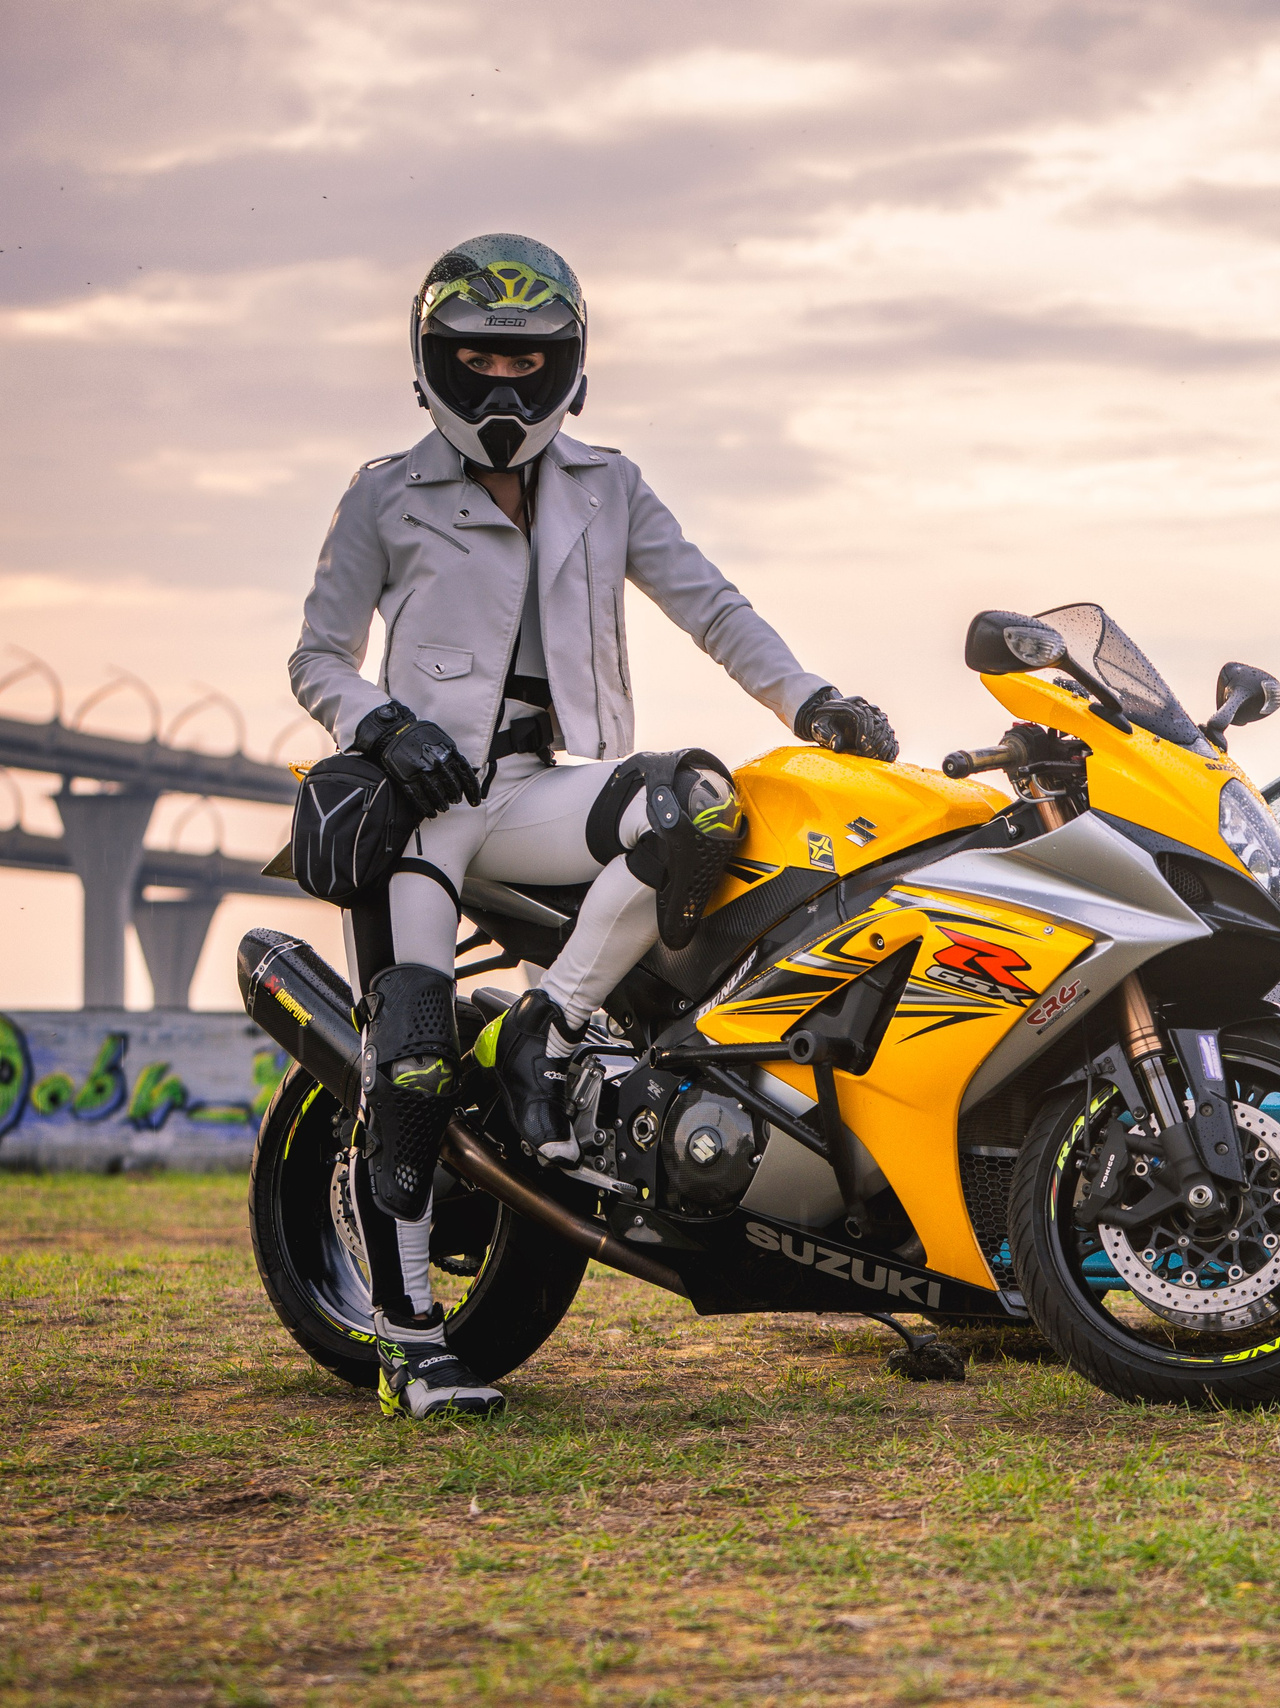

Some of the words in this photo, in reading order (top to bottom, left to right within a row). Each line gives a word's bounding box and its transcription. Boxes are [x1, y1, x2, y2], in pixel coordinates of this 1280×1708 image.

[695, 949, 757, 1022] DUNLOP
[926, 965, 1030, 1004] GSX
[1100, 1154, 1115, 1188] TOKICO
[746, 1221, 941, 1309] SUZUKI
